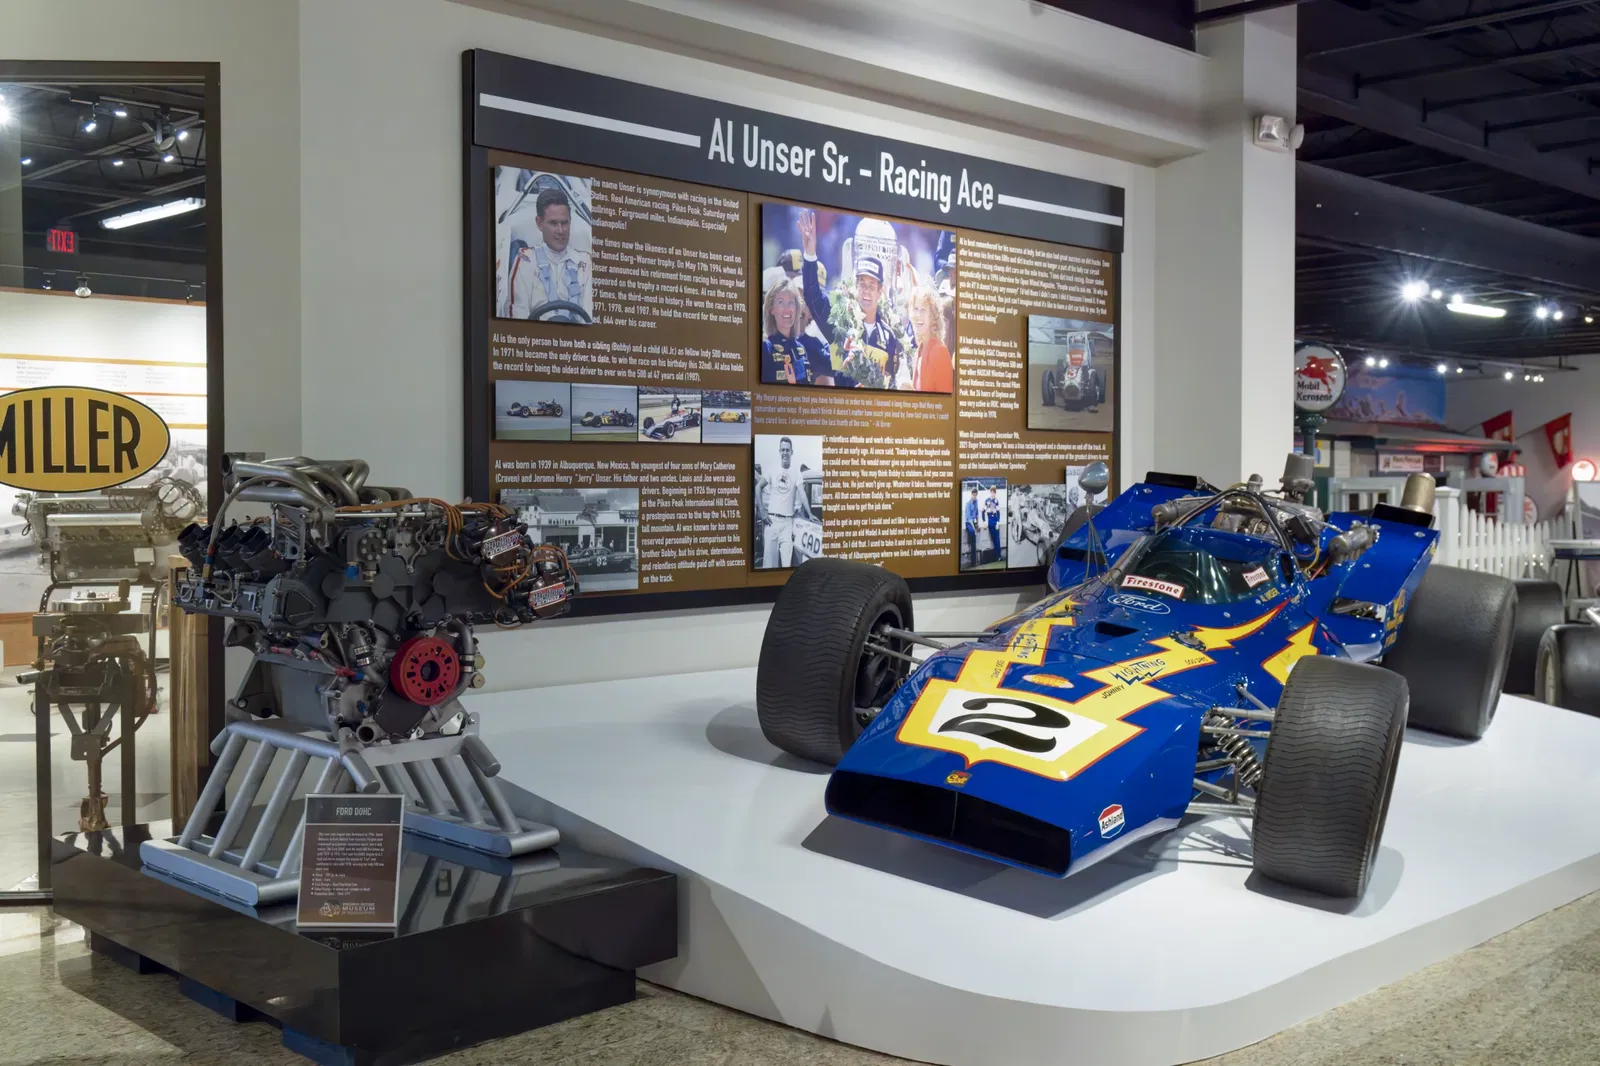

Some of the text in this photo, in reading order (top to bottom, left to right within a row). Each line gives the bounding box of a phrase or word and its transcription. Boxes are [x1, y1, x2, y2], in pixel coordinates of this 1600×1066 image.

[708, 118, 734, 164] Al
[742, 123, 816, 178] Unser
[822, 140, 851, 186] Sr.
[880, 152, 951, 213] Racing
[957, 168, 994, 210] Ace
[619, 183, 635, 192] Unser
[643, 188, 676, 199] synonymous
[678, 192, 689, 201] with
[690, 195, 706, 206] racing
[713, 197, 722, 206] the
[723, 199, 739, 208] United
[611, 194, 623, 203] Real
[624, 196, 651, 207] American
[703, 208, 726, 221] Saturday
[726, 212, 739, 222] night
[604, 238, 620, 248] times
[634, 242, 644, 250] the
[645, 244, 667, 253] likeness
[682, 248, 698, 257] Unser
[699, 250, 708, 259] has
[709, 252, 722, 260] been
[601, 251, 619, 260] famed
[620, 254, 656, 265] Borg-Warner
[685, 261, 696, 272] May
[722, 266, 736, 274] when
[518, 337, 530, 346] only
[559, 339, 573, 347] have
[592, 342, 610, 352] sibling
[611, 343, 631, 353] (Bobby)
[685, 348, 699, 356] fellow
[700, 349, 711, 359] Indy
[1297, 381, 1320, 390] Mobil
[1297, 393, 1332, 402] Kerosene
[640, 462, 663, 471] youngest
[700, 462, 712, 471] Mary
[496, 475, 520, 483] (Craven)
[556, 475, 572, 484] Henry
[575, 475, 594, 484] "Jerry"
[801, 532, 820, 553] CAD
[596, 556, 607, 566] 92
[1126, 576, 1179, 594] Firestone
[1114, 594, 1162, 611] Ford
[1108, 659, 1166, 685] LIGHTNING
[1102, 684, 1125, 699] JOHNNY
[938, 698, 1071, 753] 2
[336, 808, 353, 816] FORD
[1101, 812, 1123, 830] Ashland
